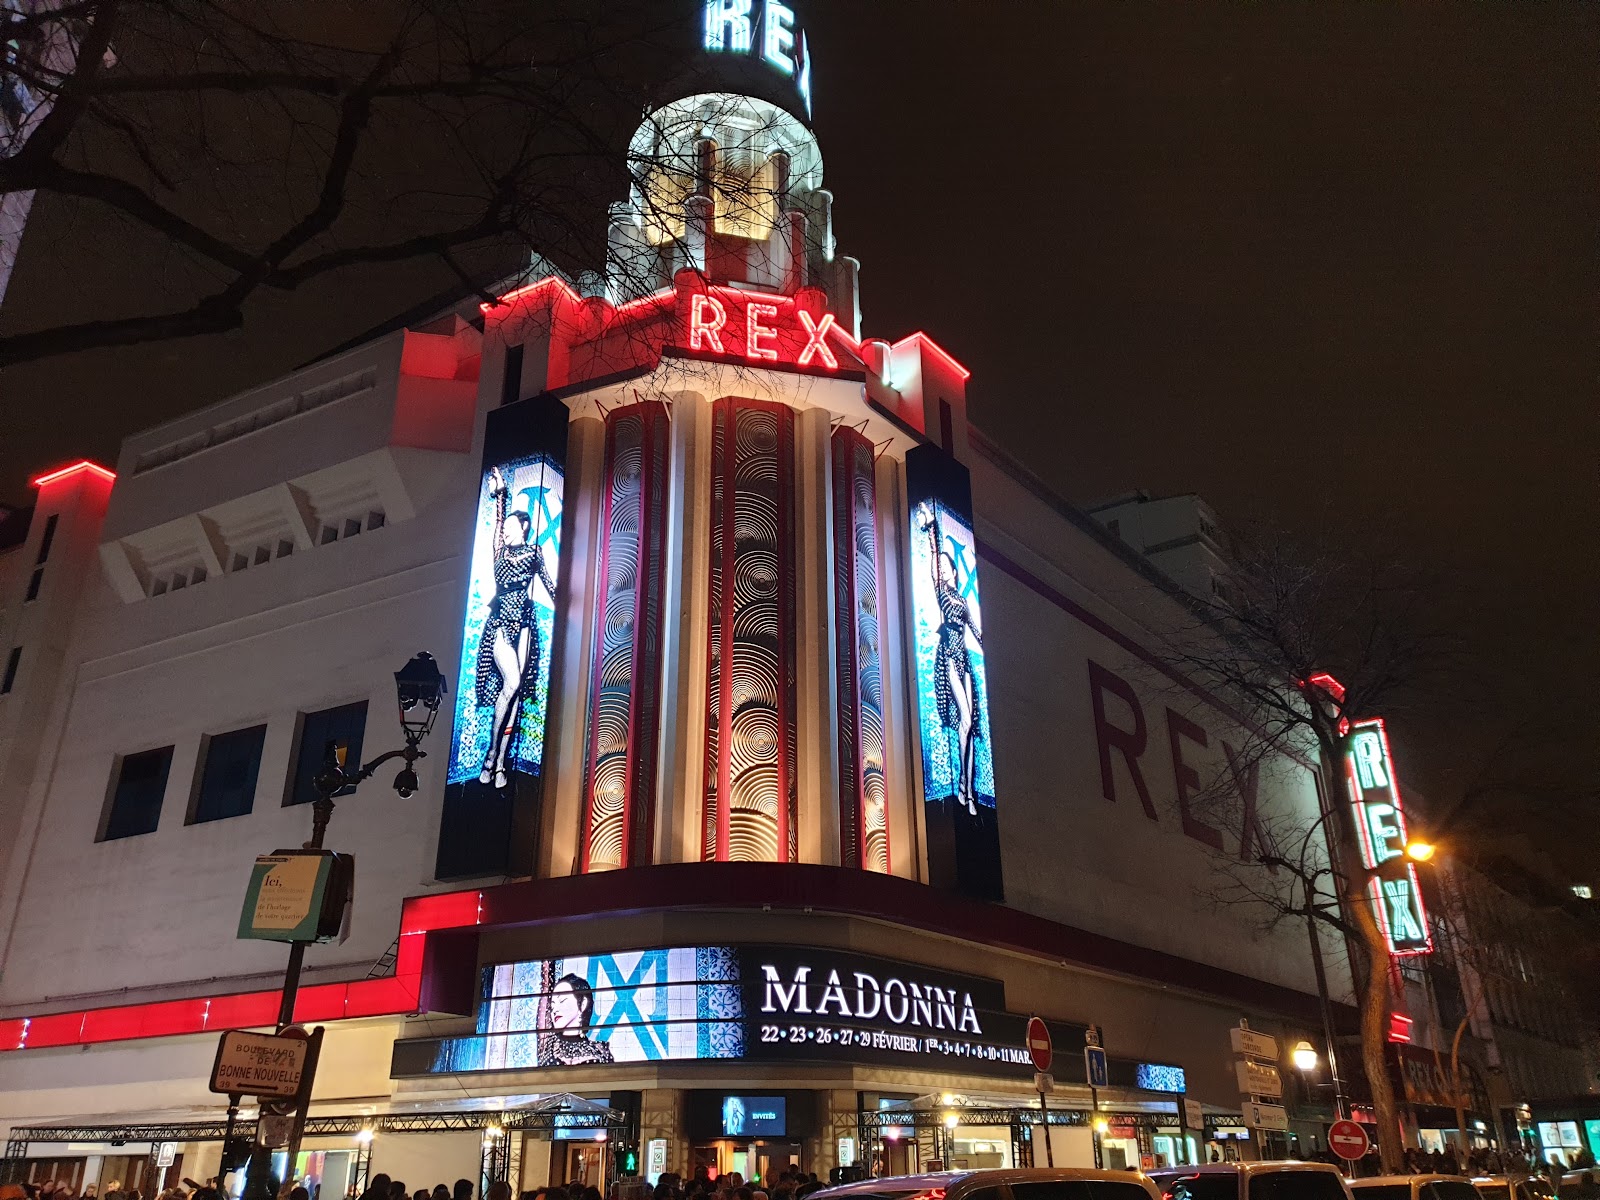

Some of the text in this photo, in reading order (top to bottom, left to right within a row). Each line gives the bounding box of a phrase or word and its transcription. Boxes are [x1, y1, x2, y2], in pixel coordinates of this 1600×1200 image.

[690, 293, 839, 369] REX
[1087, 658, 1279, 876] REX
[1353, 731, 1422, 941] REX
[264, 875, 282, 888] Ici,
[761, 965, 983, 1035] MADONNA
[236, 1044, 295, 1058] BOULEVARD
[872, 1030, 918, 1053] FÉVRIER
[1009, 1049, 1033, 1065] MAR
[220, 1064, 300, 1084] BONNE NOUVELLE
[257, 1058, 271, 1066] DE
[220, 1080, 231, 1088] 39
